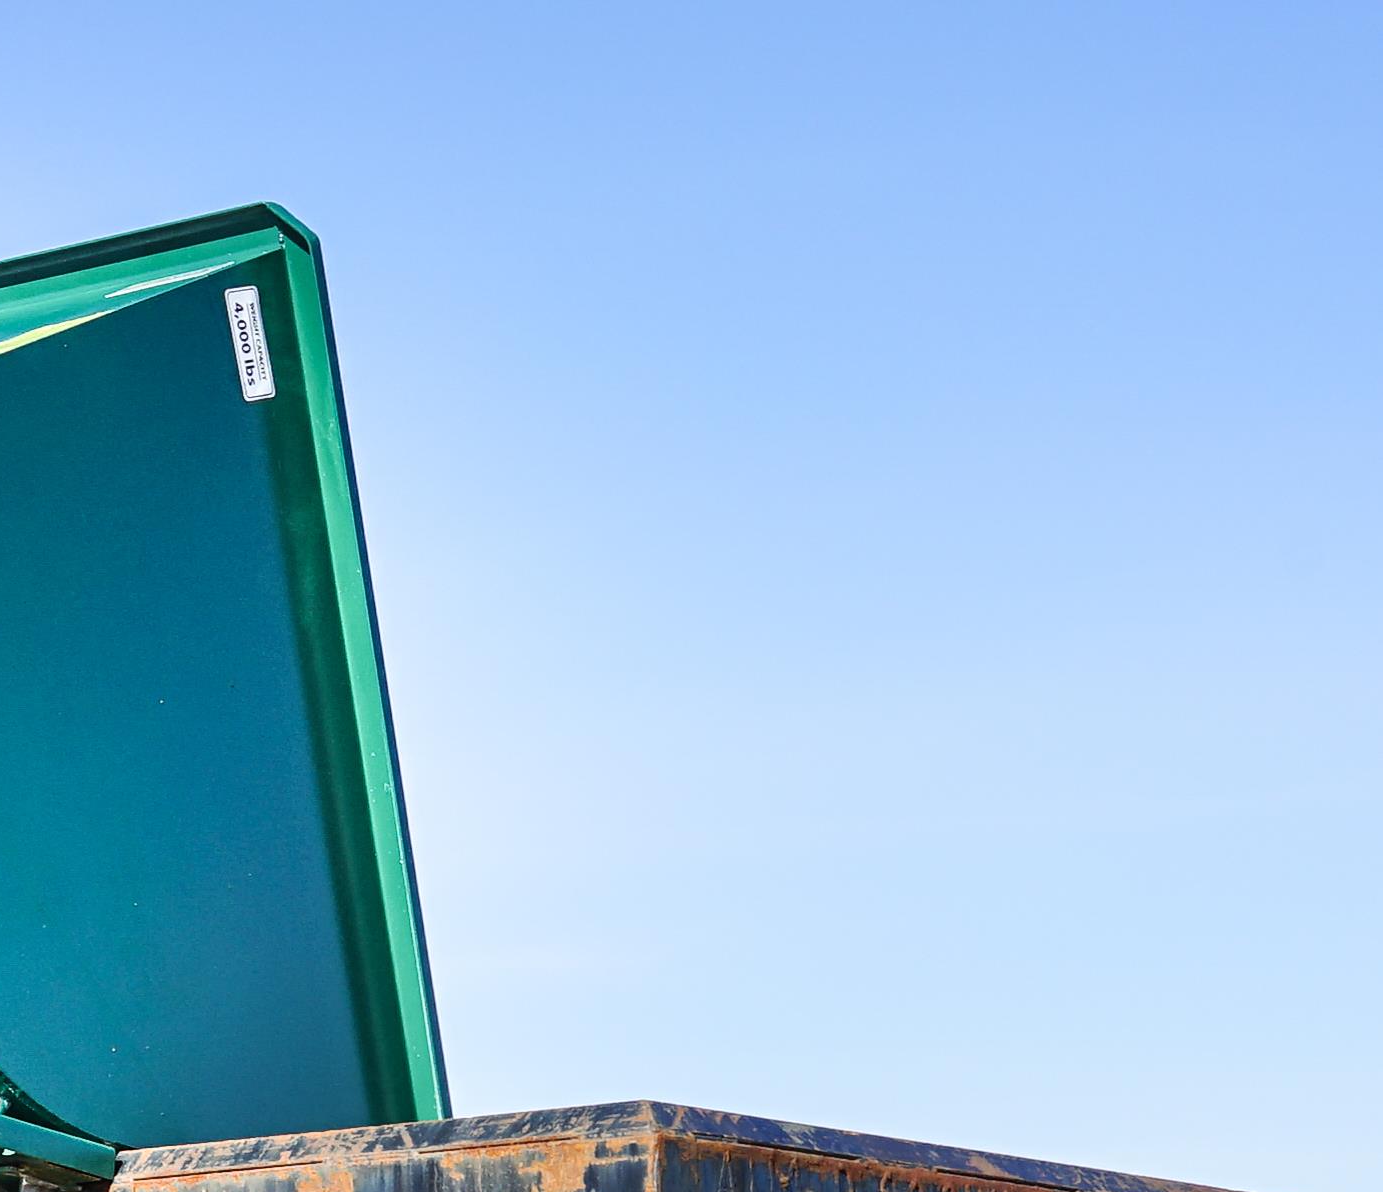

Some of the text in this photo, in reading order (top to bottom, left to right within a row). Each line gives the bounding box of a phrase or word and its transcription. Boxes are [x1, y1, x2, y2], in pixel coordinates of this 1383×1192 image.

[234, 302, 255, 386] 4,000 lbs
[255, 338, 267, 380] CAPACITY
